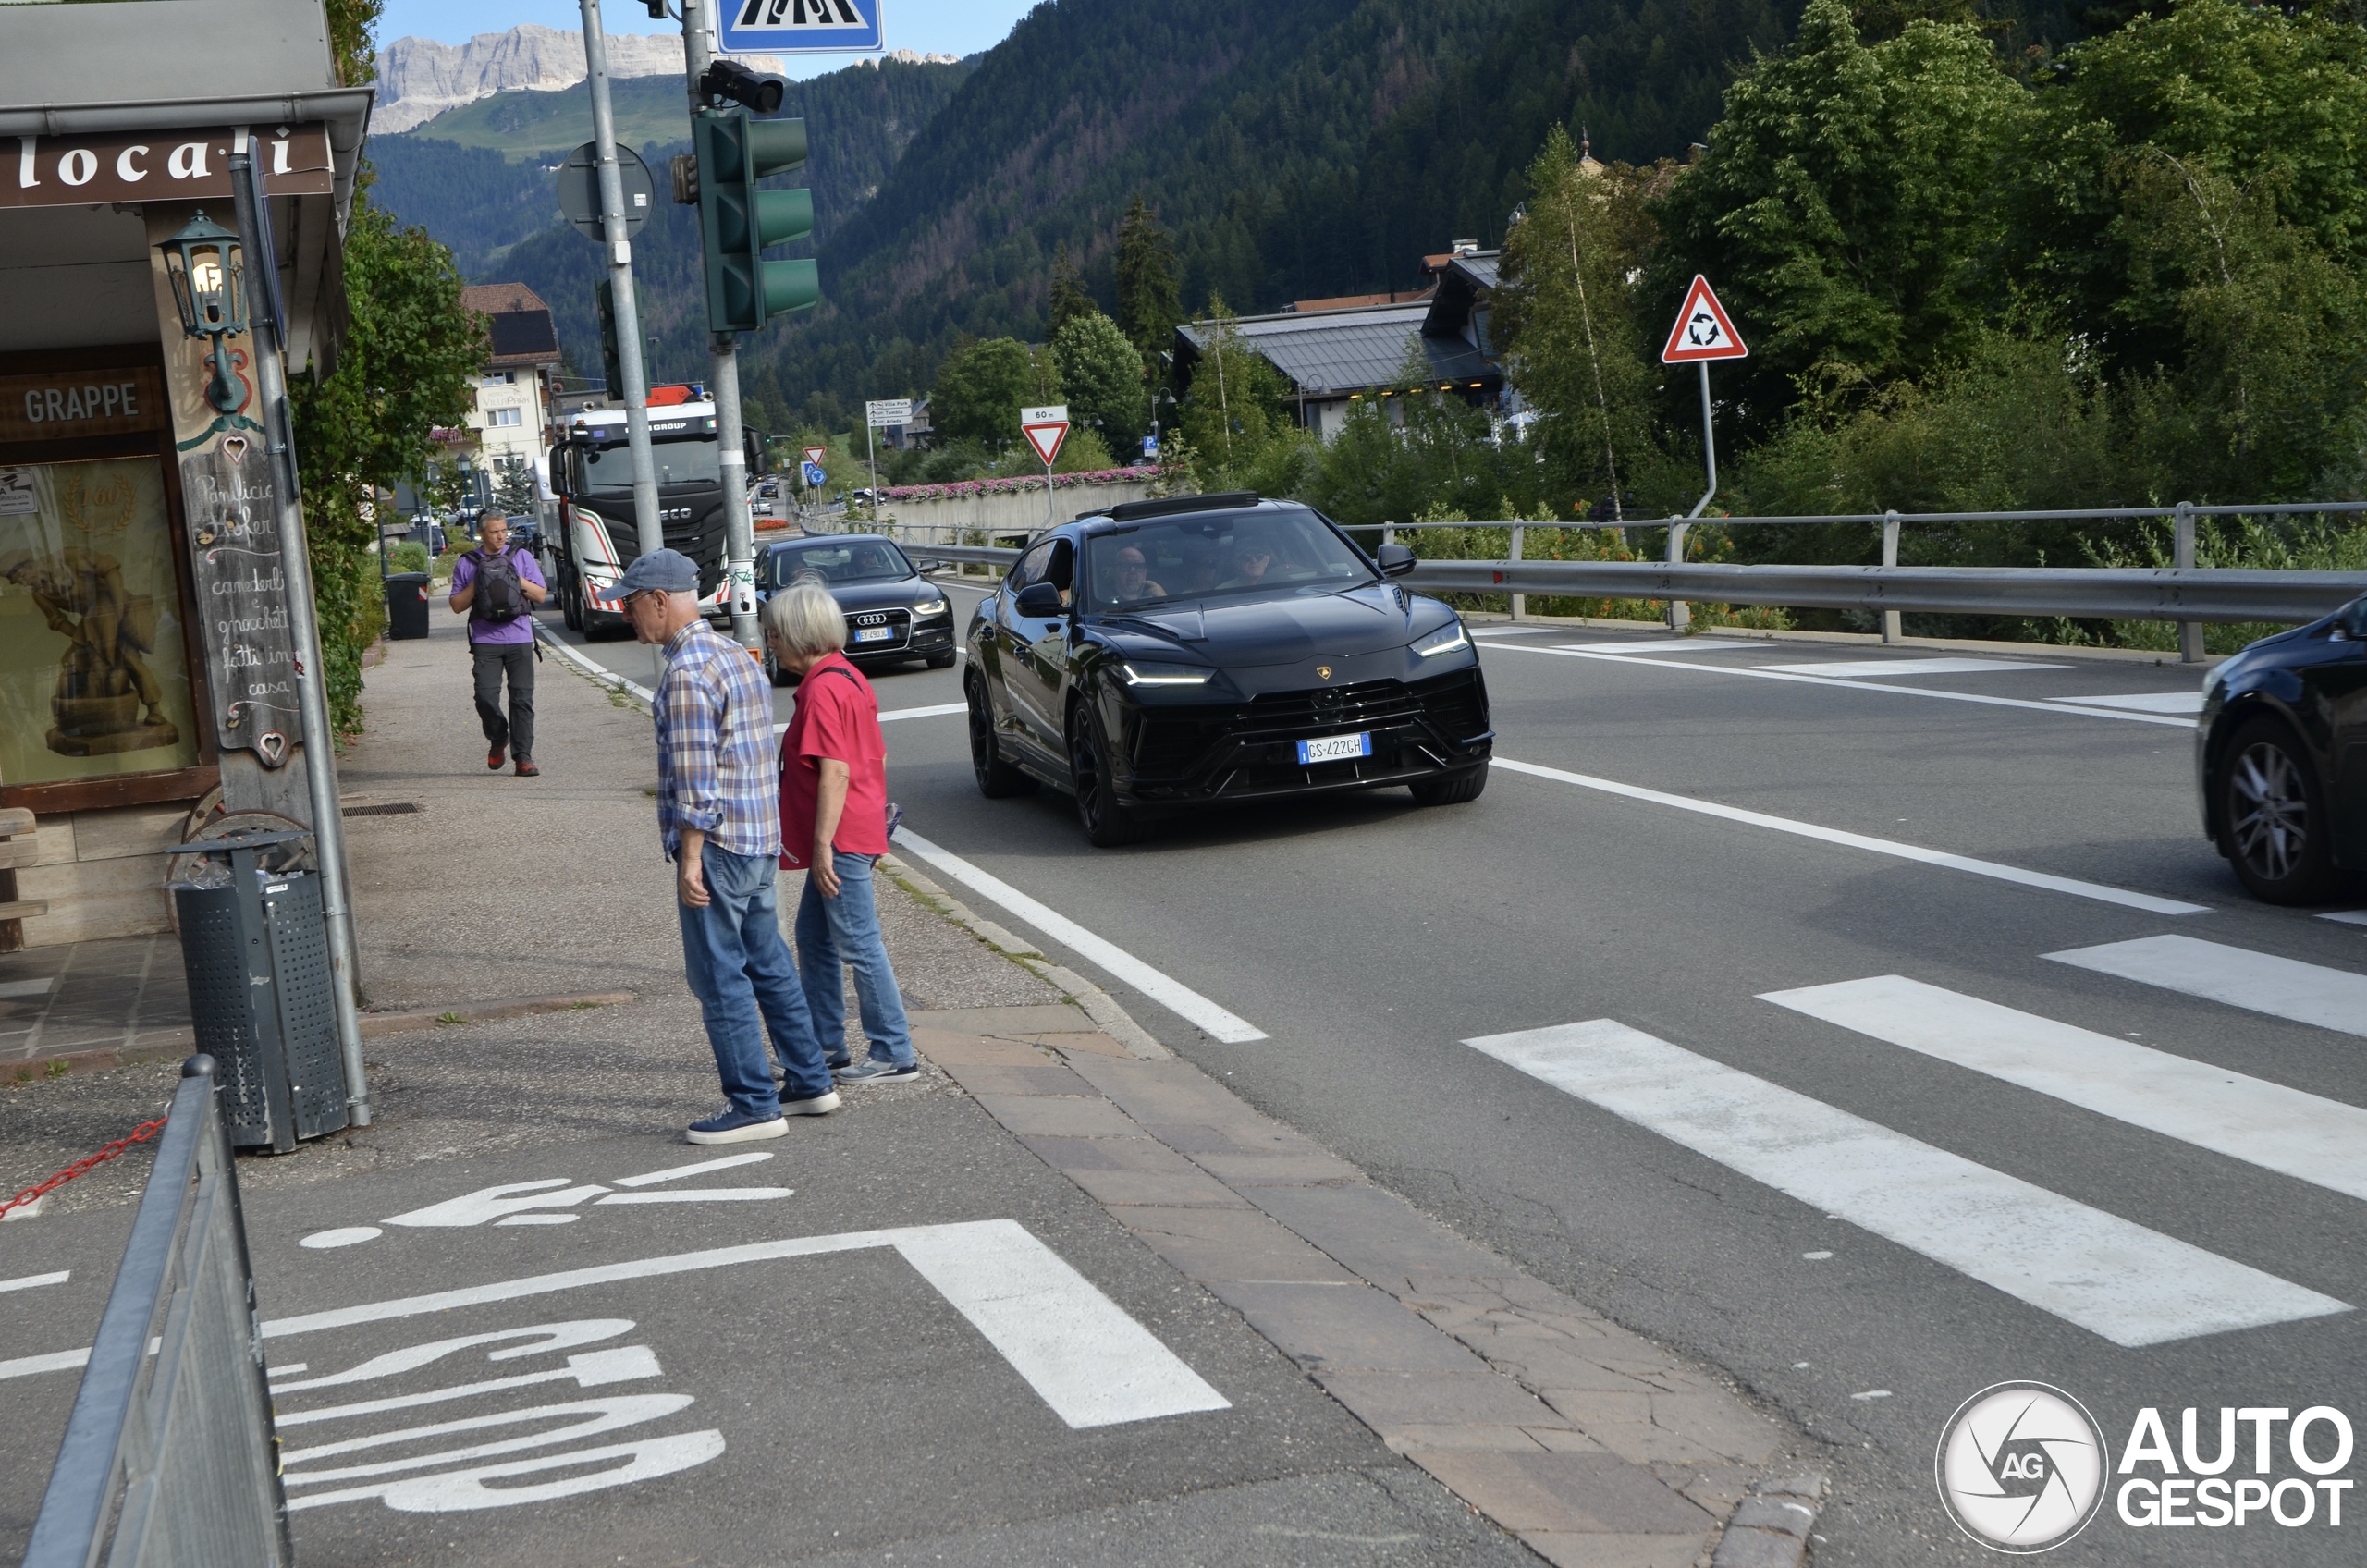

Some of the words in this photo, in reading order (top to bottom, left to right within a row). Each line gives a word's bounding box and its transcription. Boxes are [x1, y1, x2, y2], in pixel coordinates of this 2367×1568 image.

[25, 383, 139, 423] GRAPPE
[653, 423, 687, 431] GROUP
[1147, 437, 1154, 447] P
[81, 484, 122, 507] 160
[659, 508, 692, 521] ECO
[212, 566, 285, 595] canederli
[218, 606, 289, 645] gnocchett
[222, 644, 262, 684] fatti
[267, 646, 291, 665] in
[249, 680, 290, 696] casa
[267, 1318, 727, 1513] STOP
